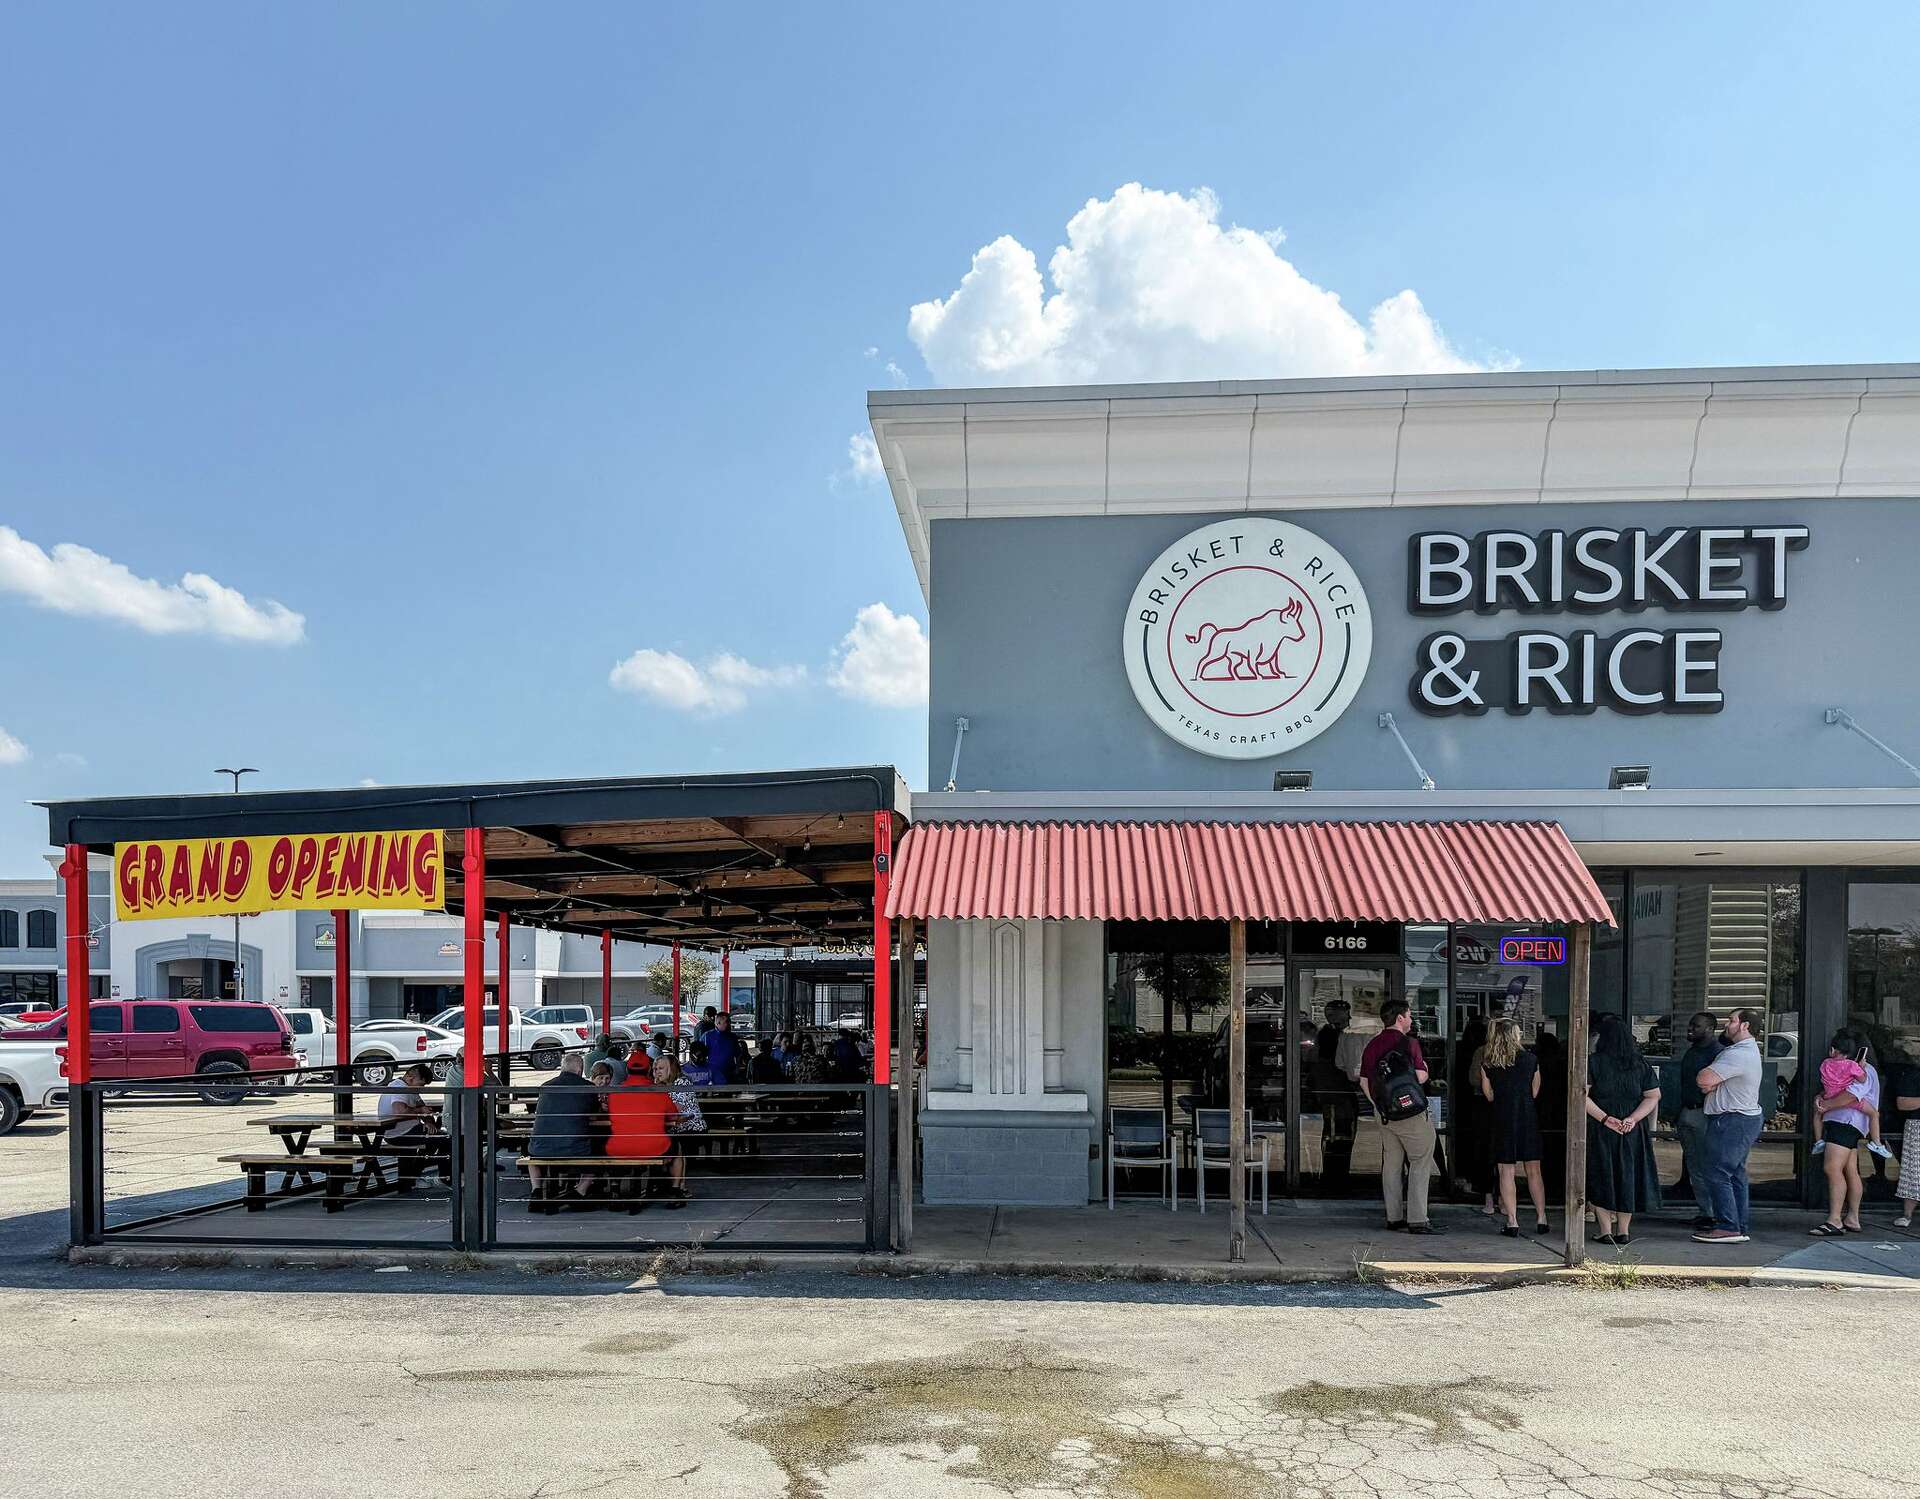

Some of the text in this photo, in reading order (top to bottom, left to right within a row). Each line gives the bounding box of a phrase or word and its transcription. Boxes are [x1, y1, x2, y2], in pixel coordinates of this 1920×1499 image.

[1139, 535, 1355, 625] BRISKET & RICE
[1419, 527, 1809, 605] BRISKET
[1420, 631, 1723, 706] & RICE
[1177, 713, 1313, 744] TEXAS CRAFT BBQ
[119, 831, 438, 912] GRAND OPENING
[1324, 936, 1367, 950] 6166
[1503, 940, 1563, 961] OPEN
